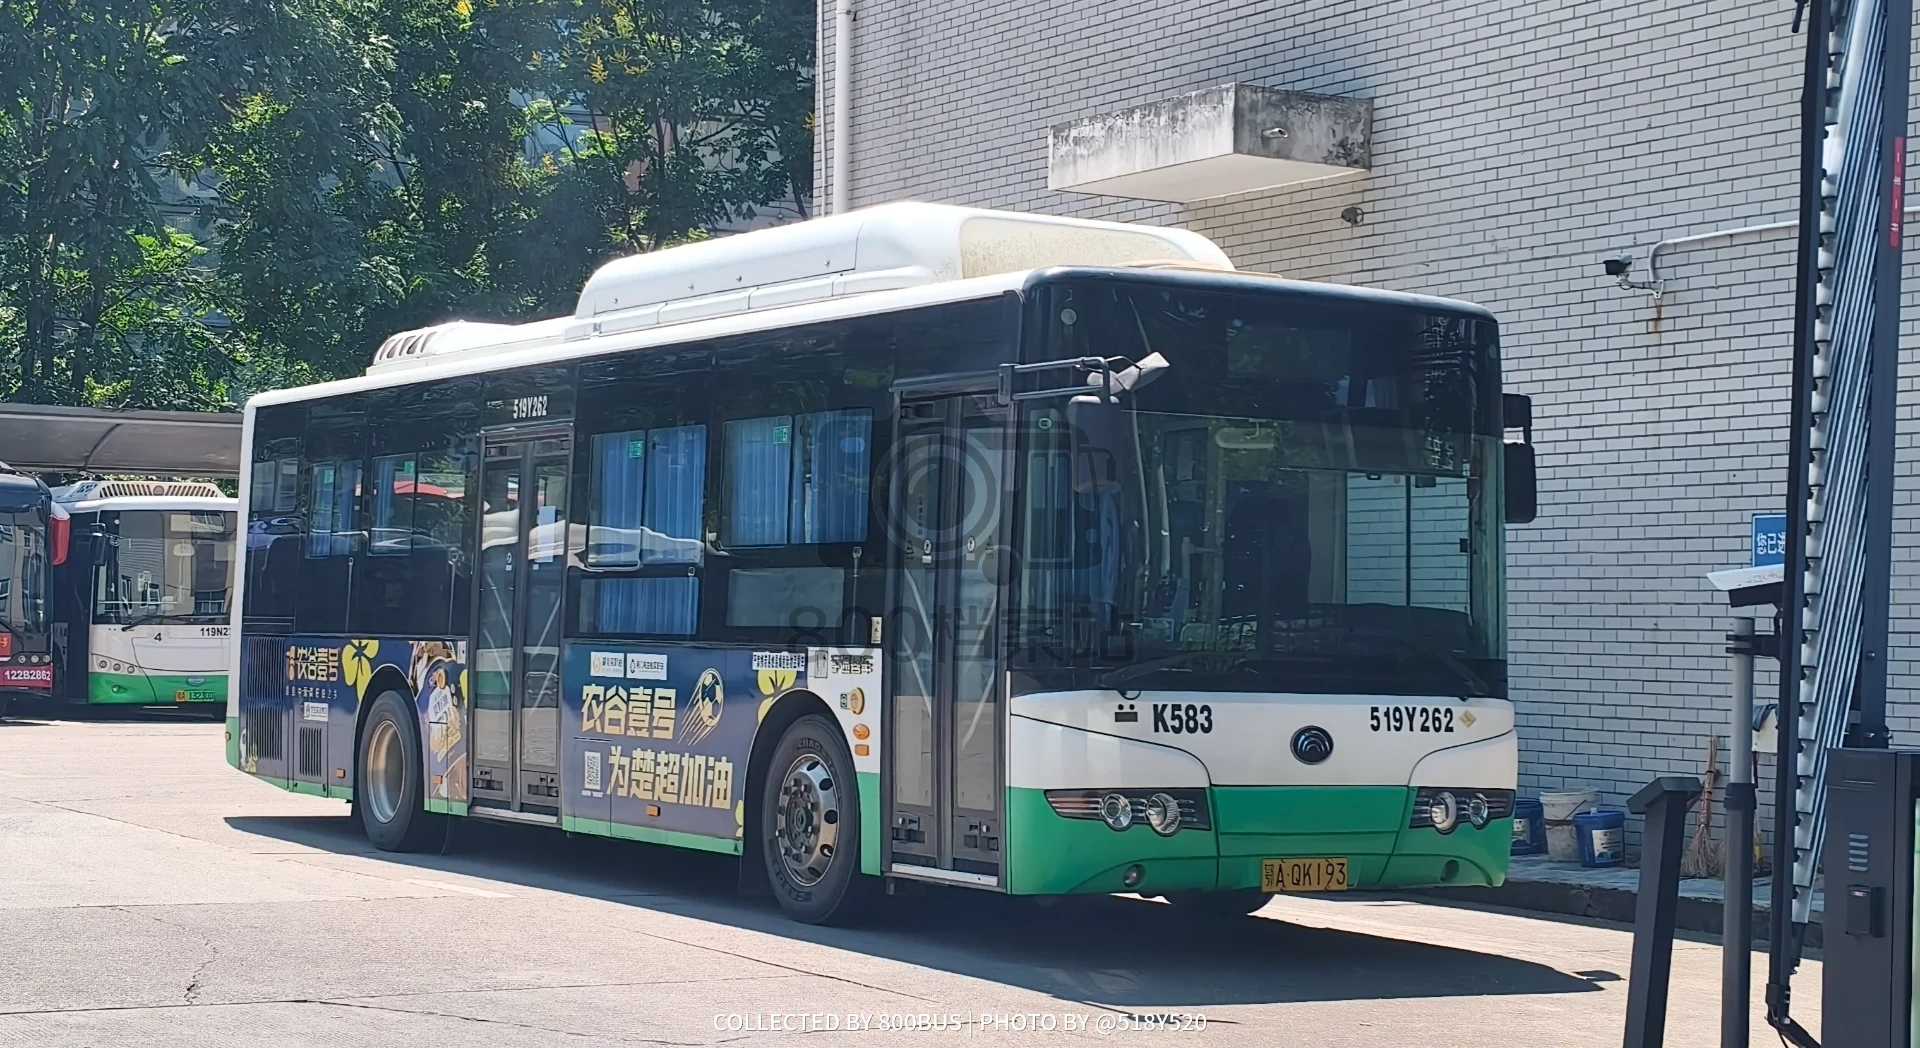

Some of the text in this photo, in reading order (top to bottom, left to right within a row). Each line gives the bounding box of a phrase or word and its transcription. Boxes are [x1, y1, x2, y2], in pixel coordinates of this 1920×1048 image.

[513, 395, 548, 419] 519Y262
[200, 627, 231, 637] 119N2
[4, 670, 51, 681] 122B2862
[297, 647, 339, 681] 农谷壹号
[581, 683, 677, 740] 农谷壹号
[1153, 704, 1214, 734] K583
[1369, 705, 1454, 733] 519Y262
[606, 745, 733, 810] 为楚超加油
